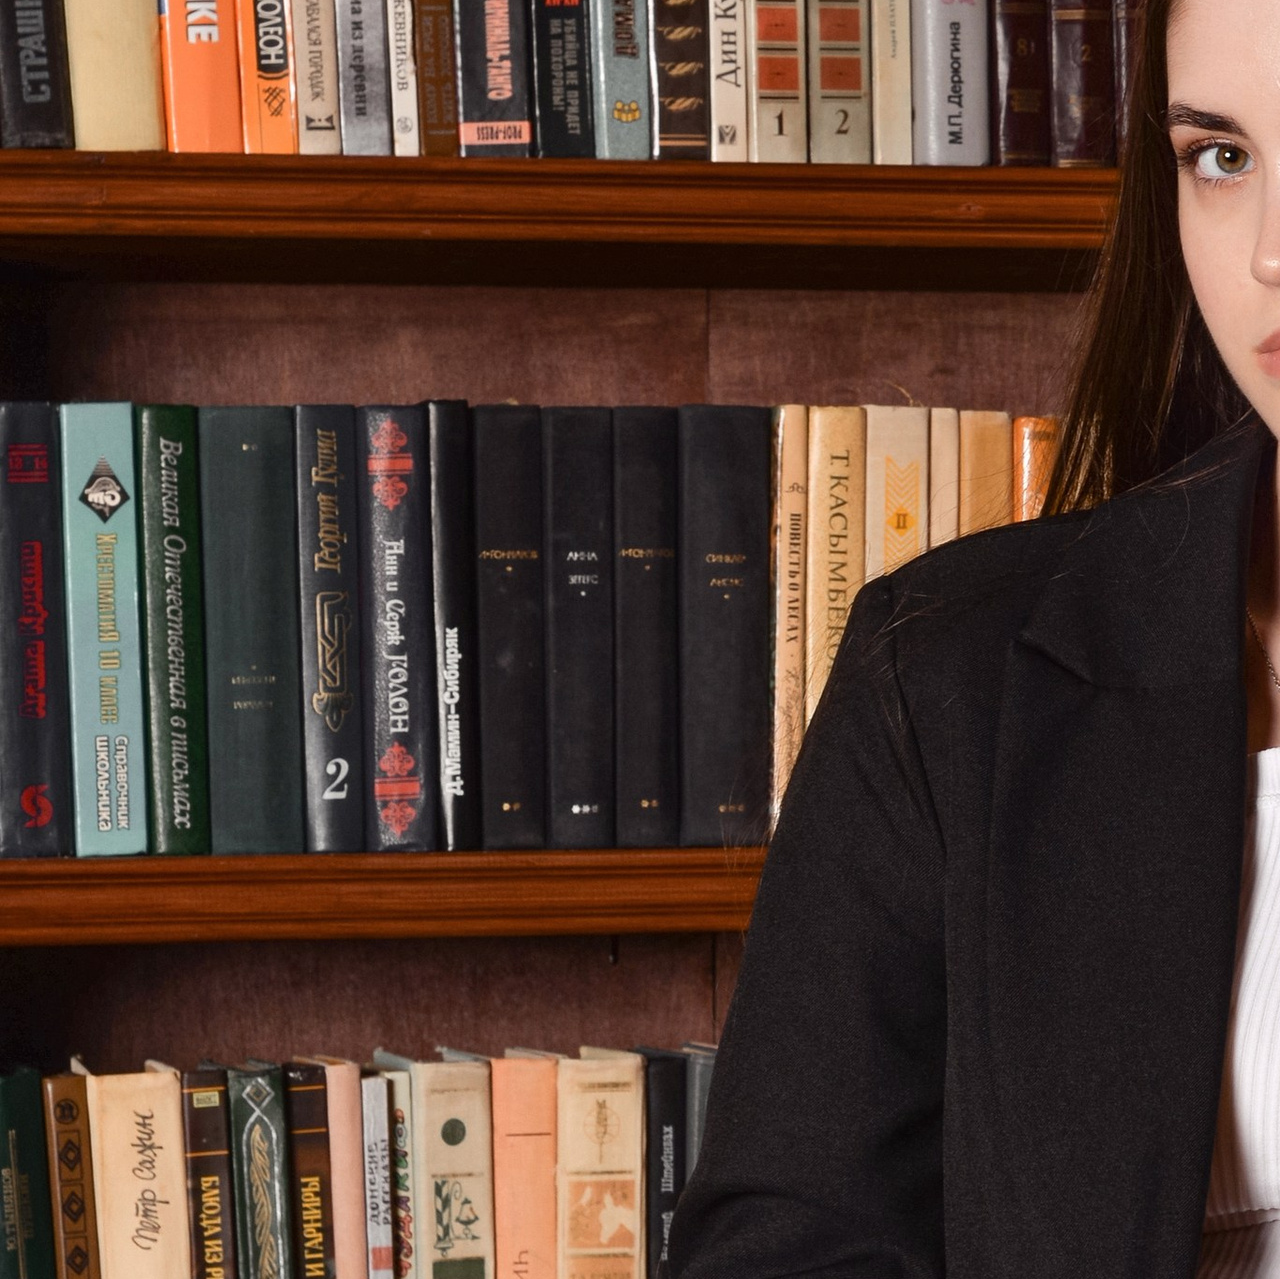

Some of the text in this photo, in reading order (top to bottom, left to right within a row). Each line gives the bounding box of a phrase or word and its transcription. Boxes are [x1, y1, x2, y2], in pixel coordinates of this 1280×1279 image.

[349, 18, 364, 41] из
[714, 30, 741, 88] Дин
[305, 49, 325, 101] ГОРОДОК
[349, 42, 369, 117] деревни
[549, 18, 565, 111] НА ПОХОРОНЫ!
[562, 17, 580, 135] УБИЙЦА НЕ ПРИДЕТ
[947, 21, 967, 145] М.П. Дерюгина
[773, 108, 789, 137] 1
[834, 108, 850, 135] 2
[829, 449, 851, 467] Т.
[313, 490, 347, 575] Георгий
[381, 538, 406, 577] Анн
[566, 551, 599, 561] АННА
[385, 580, 399, 592] и
[785, 513, 802, 644] ПОВЕСТЬ О ЛЕСАХ
[17, 540, 48, 719] Агата Кристи
[159, 436, 192, 830] Великая Отечественная в письмах
[382, 598, 406, 647] Серж
[98, 649, 122, 669] 10
[442, 626, 464, 796] Д.Мамин-Сибиряк
[94, 733, 113, 832] школьника
[113, 734, 132, 829] Справочник
[322, 757, 349, 800] 2
[130, 1108, 164, 1181] Сажин
[199, 1175, 222, 1237] БЛЮДА
[366, 1141, 382, 1226] ДОНСКИЕ
[380, 1138, 392, 1226] РАССКАЗЫ
[204, 1239, 223, 1263] ИЗ
[300, 1176, 324, 1260] ГАРНИРЫ
[304, 1262, 326, 1277] И
